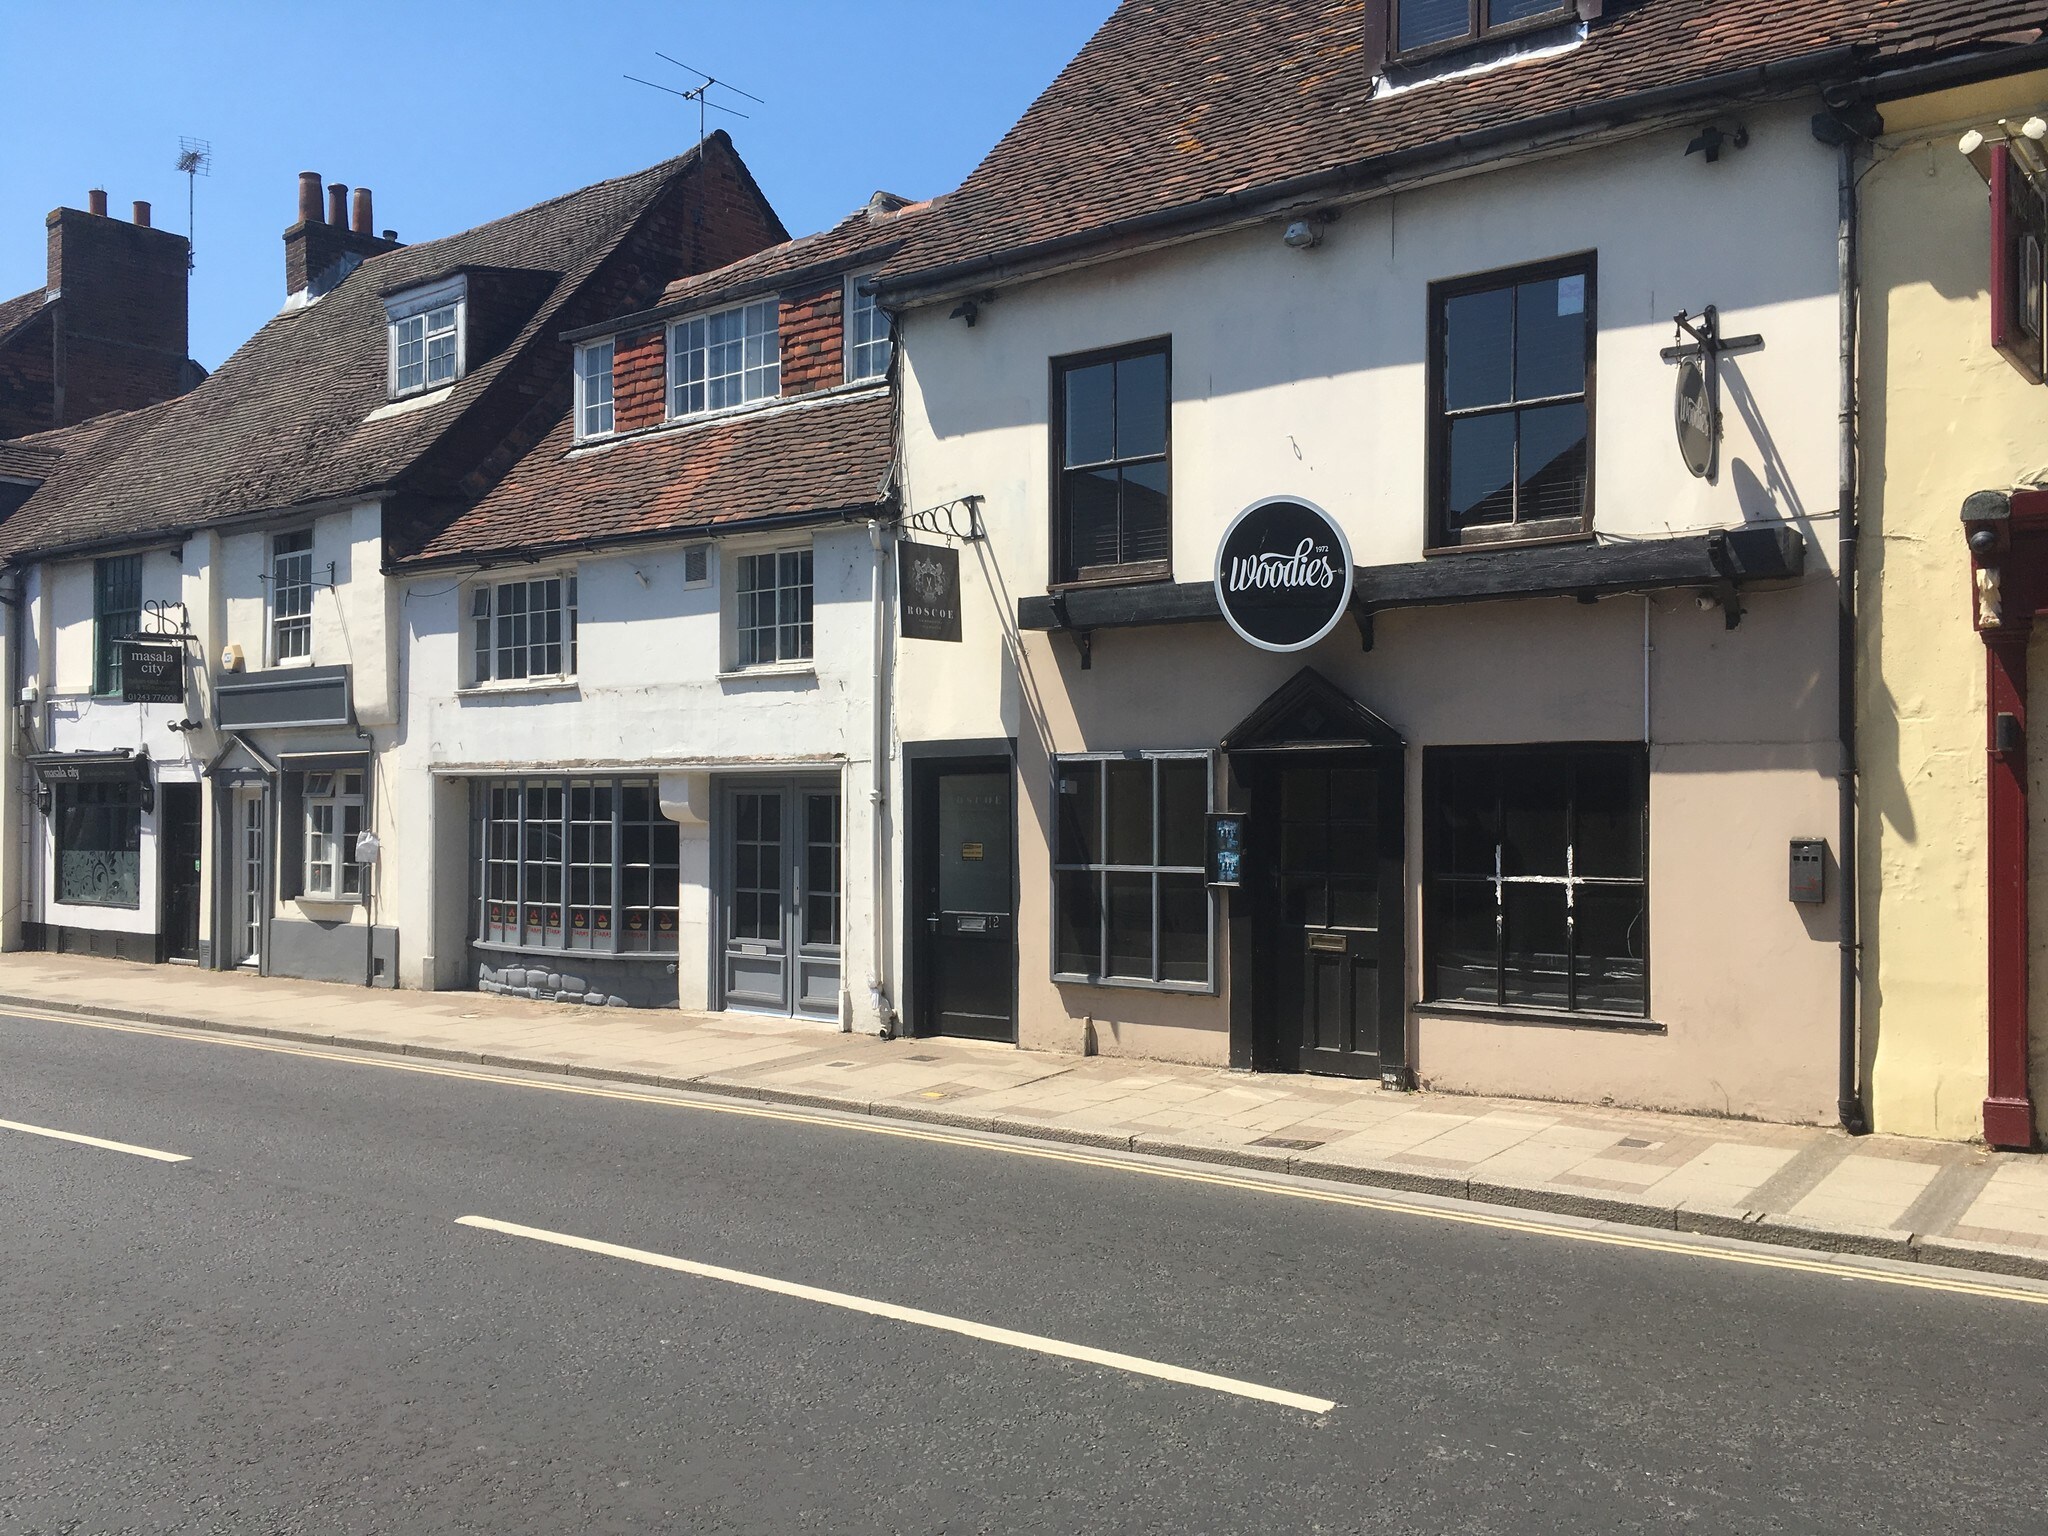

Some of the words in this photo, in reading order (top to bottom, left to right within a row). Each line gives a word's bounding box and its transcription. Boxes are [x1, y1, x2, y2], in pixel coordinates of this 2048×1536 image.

[1315, 545, 1329, 553] 1972
[1229, 537, 1337, 592] Woodies
[907, 605, 954, 620] ROSCOE
[131, 651, 173, 663] masala
[141, 662, 164, 677] city
[127, 693, 150, 701] 01243
[43, 766, 67, 778] masala
[67, 766, 79, 780] city
[988, 915, 999, 928] 12
